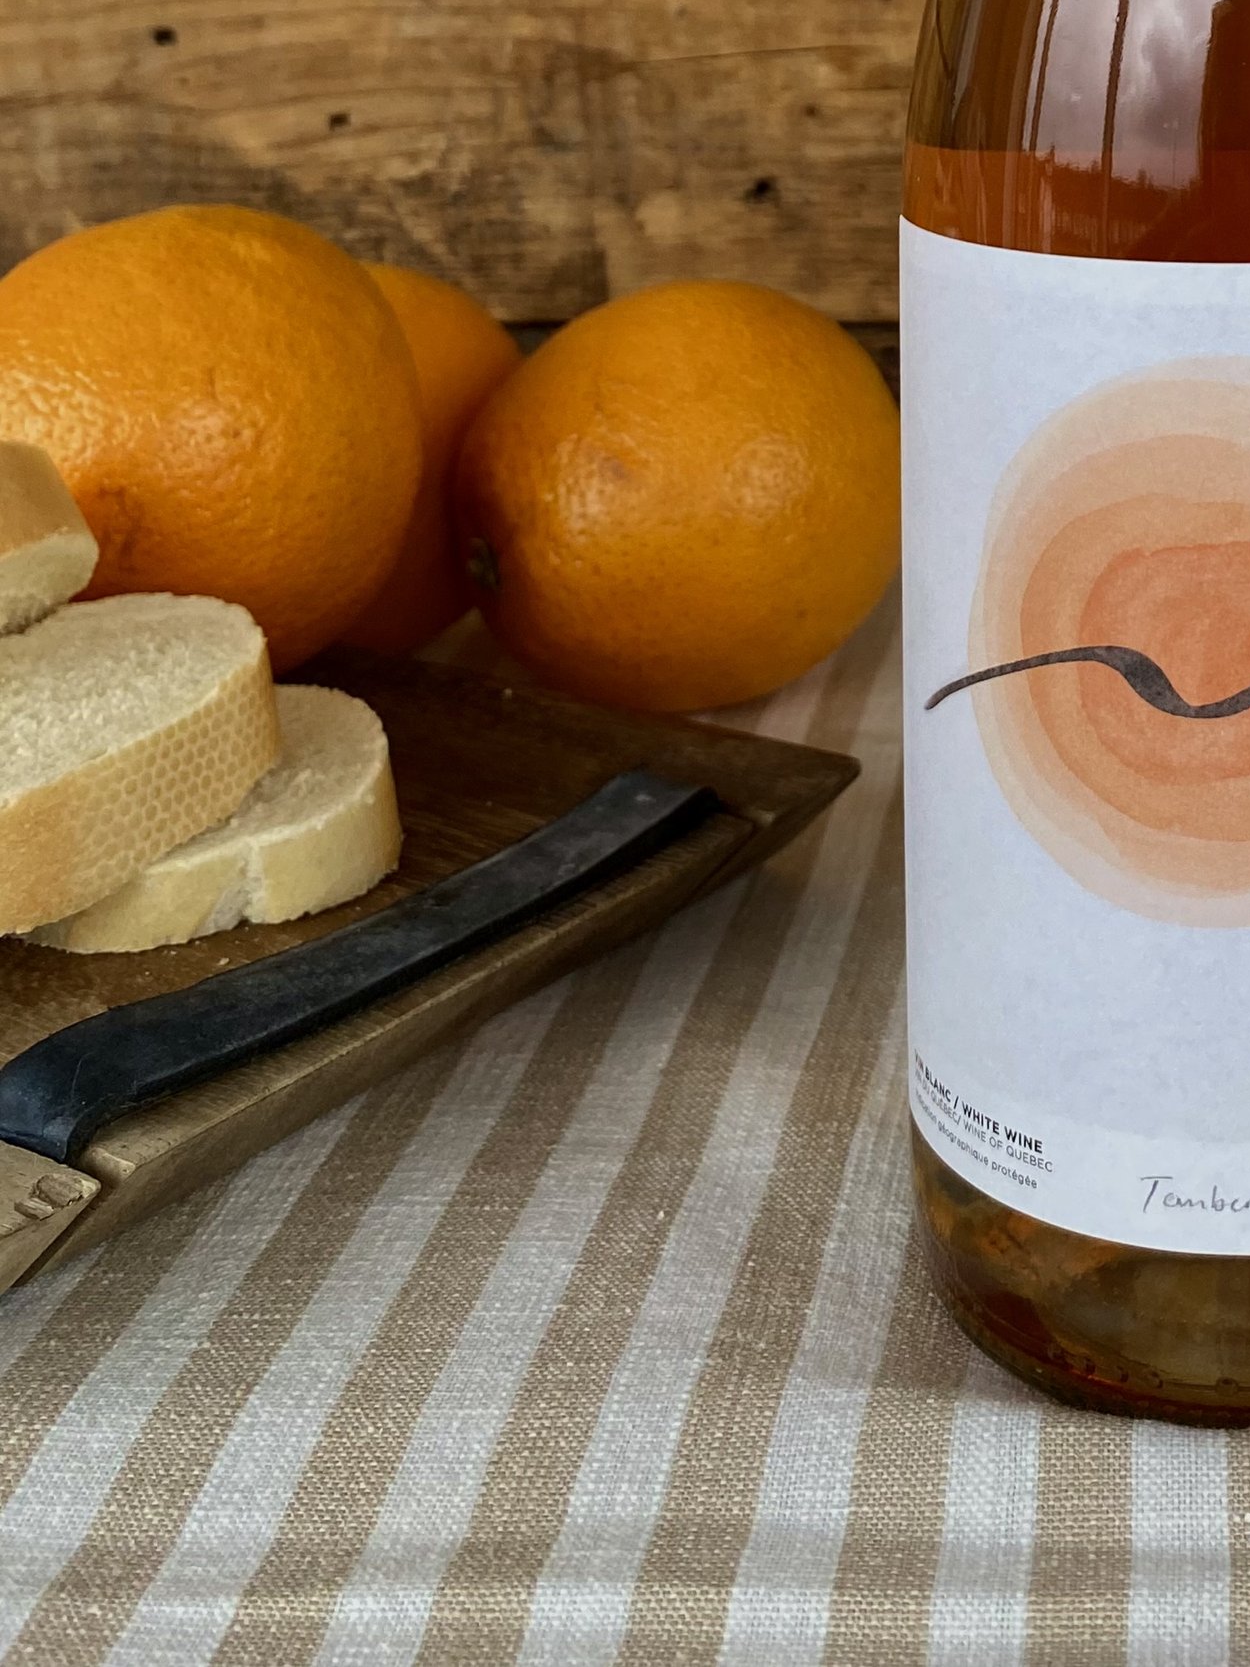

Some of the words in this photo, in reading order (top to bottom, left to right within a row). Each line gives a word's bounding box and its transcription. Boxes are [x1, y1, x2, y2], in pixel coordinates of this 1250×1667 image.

[925, 1066, 952, 1103] BLANC
[962, 1100, 1000, 1136] WHITE
[1004, 1124, 1044, 1154] WINE
[963, 1118, 987, 1143] WINE
[989, 1135, 1004, 1151] OF
[1006, 1144, 1054, 1173] QUEBEC
[991, 1160, 1038, 1189] protégée
